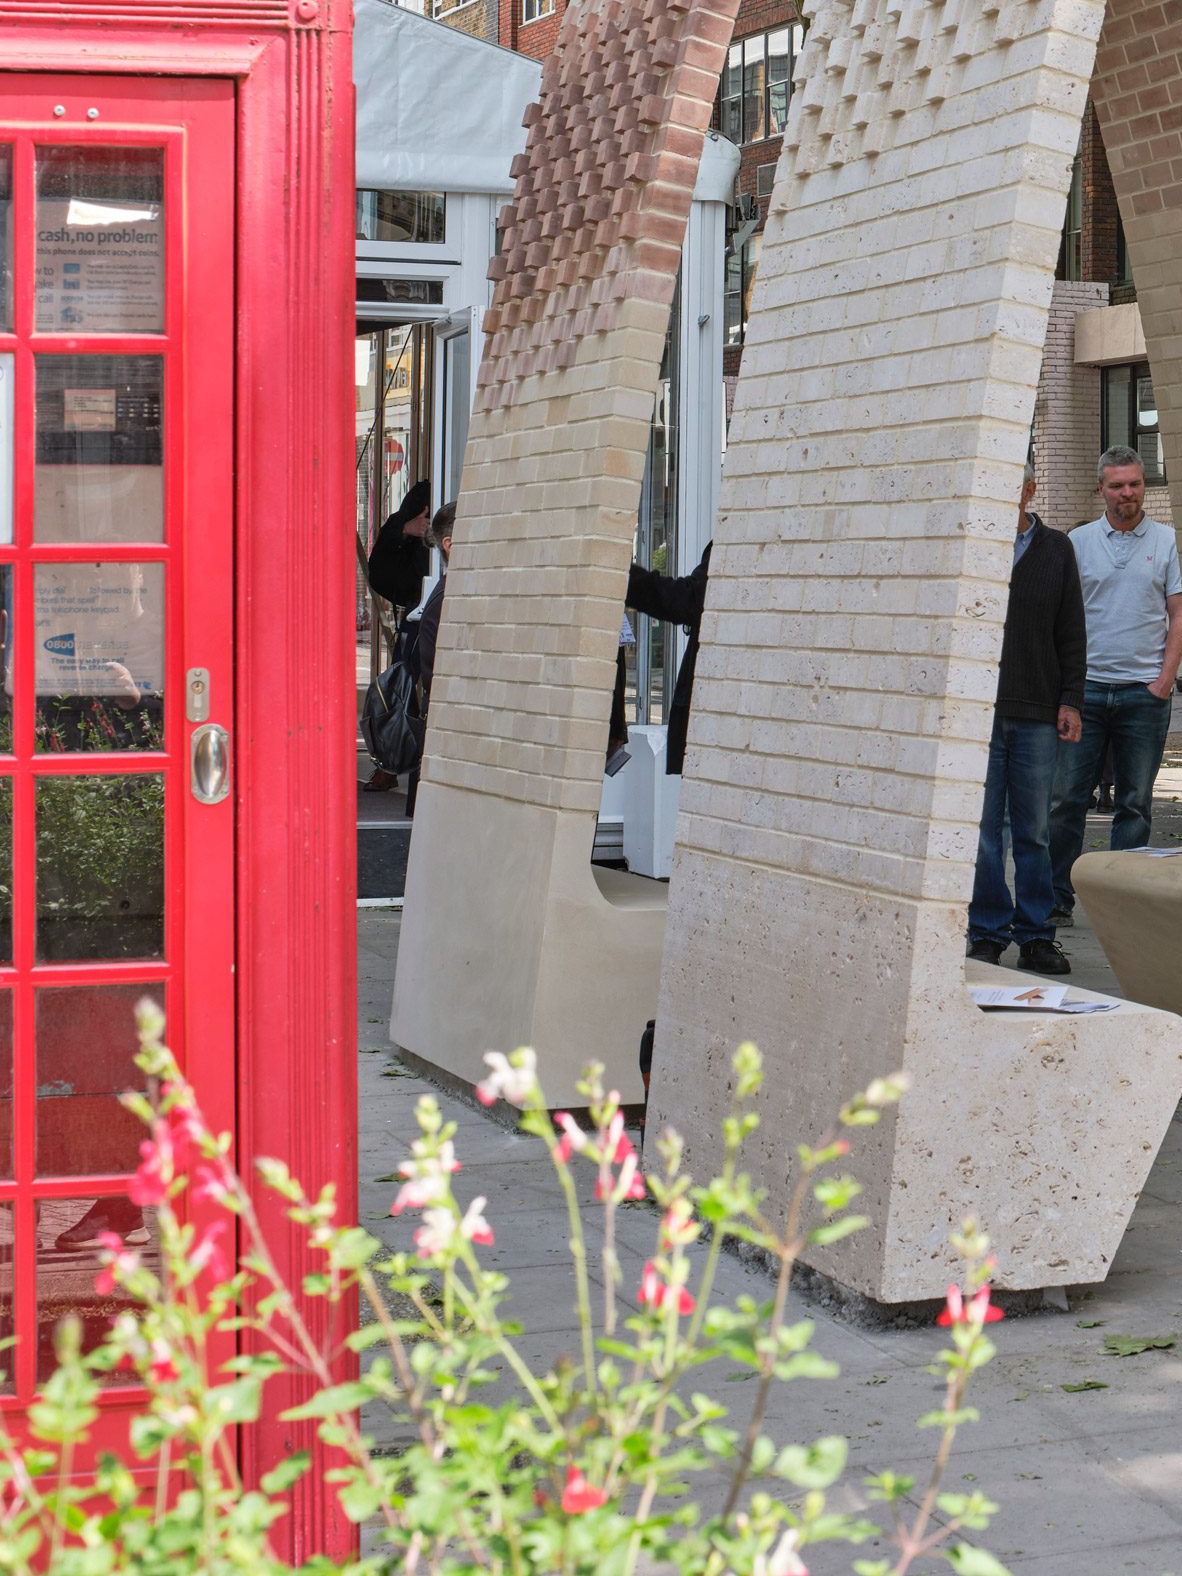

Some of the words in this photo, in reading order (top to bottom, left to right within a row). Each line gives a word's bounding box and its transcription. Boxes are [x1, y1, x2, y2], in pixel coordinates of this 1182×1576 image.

[38, 228, 75, 244] cash,
[76, 231, 95, 243] no
[53, 247, 76, 257] phone
[78, 247, 96, 257] does
[97, 248, 111, 257] not
[112, 249, 137, 259] accept
[43, 266, 54, 276] to
[46, 640, 74, 649] 0800
